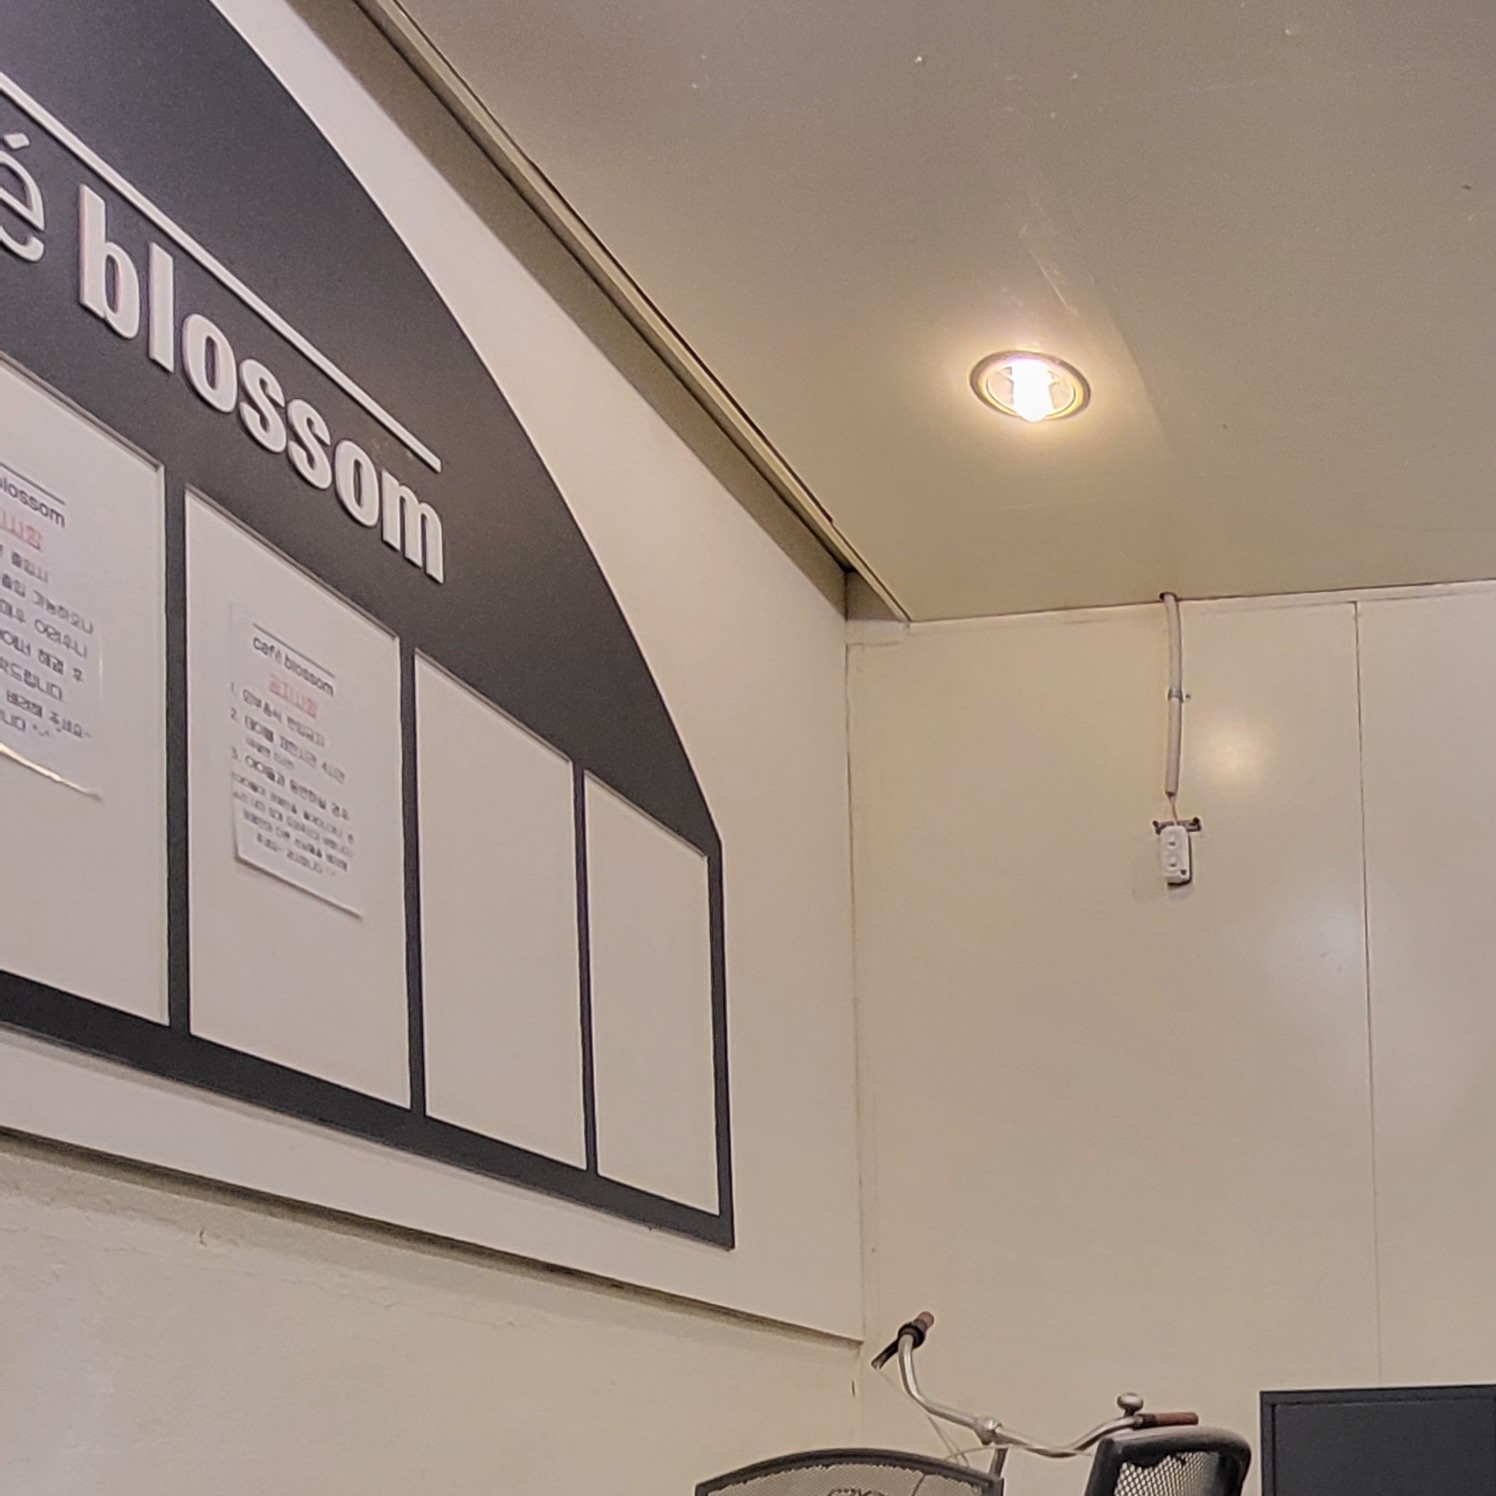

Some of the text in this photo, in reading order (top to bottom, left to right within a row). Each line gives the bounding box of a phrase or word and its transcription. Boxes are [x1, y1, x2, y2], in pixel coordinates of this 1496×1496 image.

[79, 183, 445, 584] blossom
[0, 477, 65, 528] lossom
[0, 629, 31, 657] 에서
[0, 709, 27, 733] 니다
